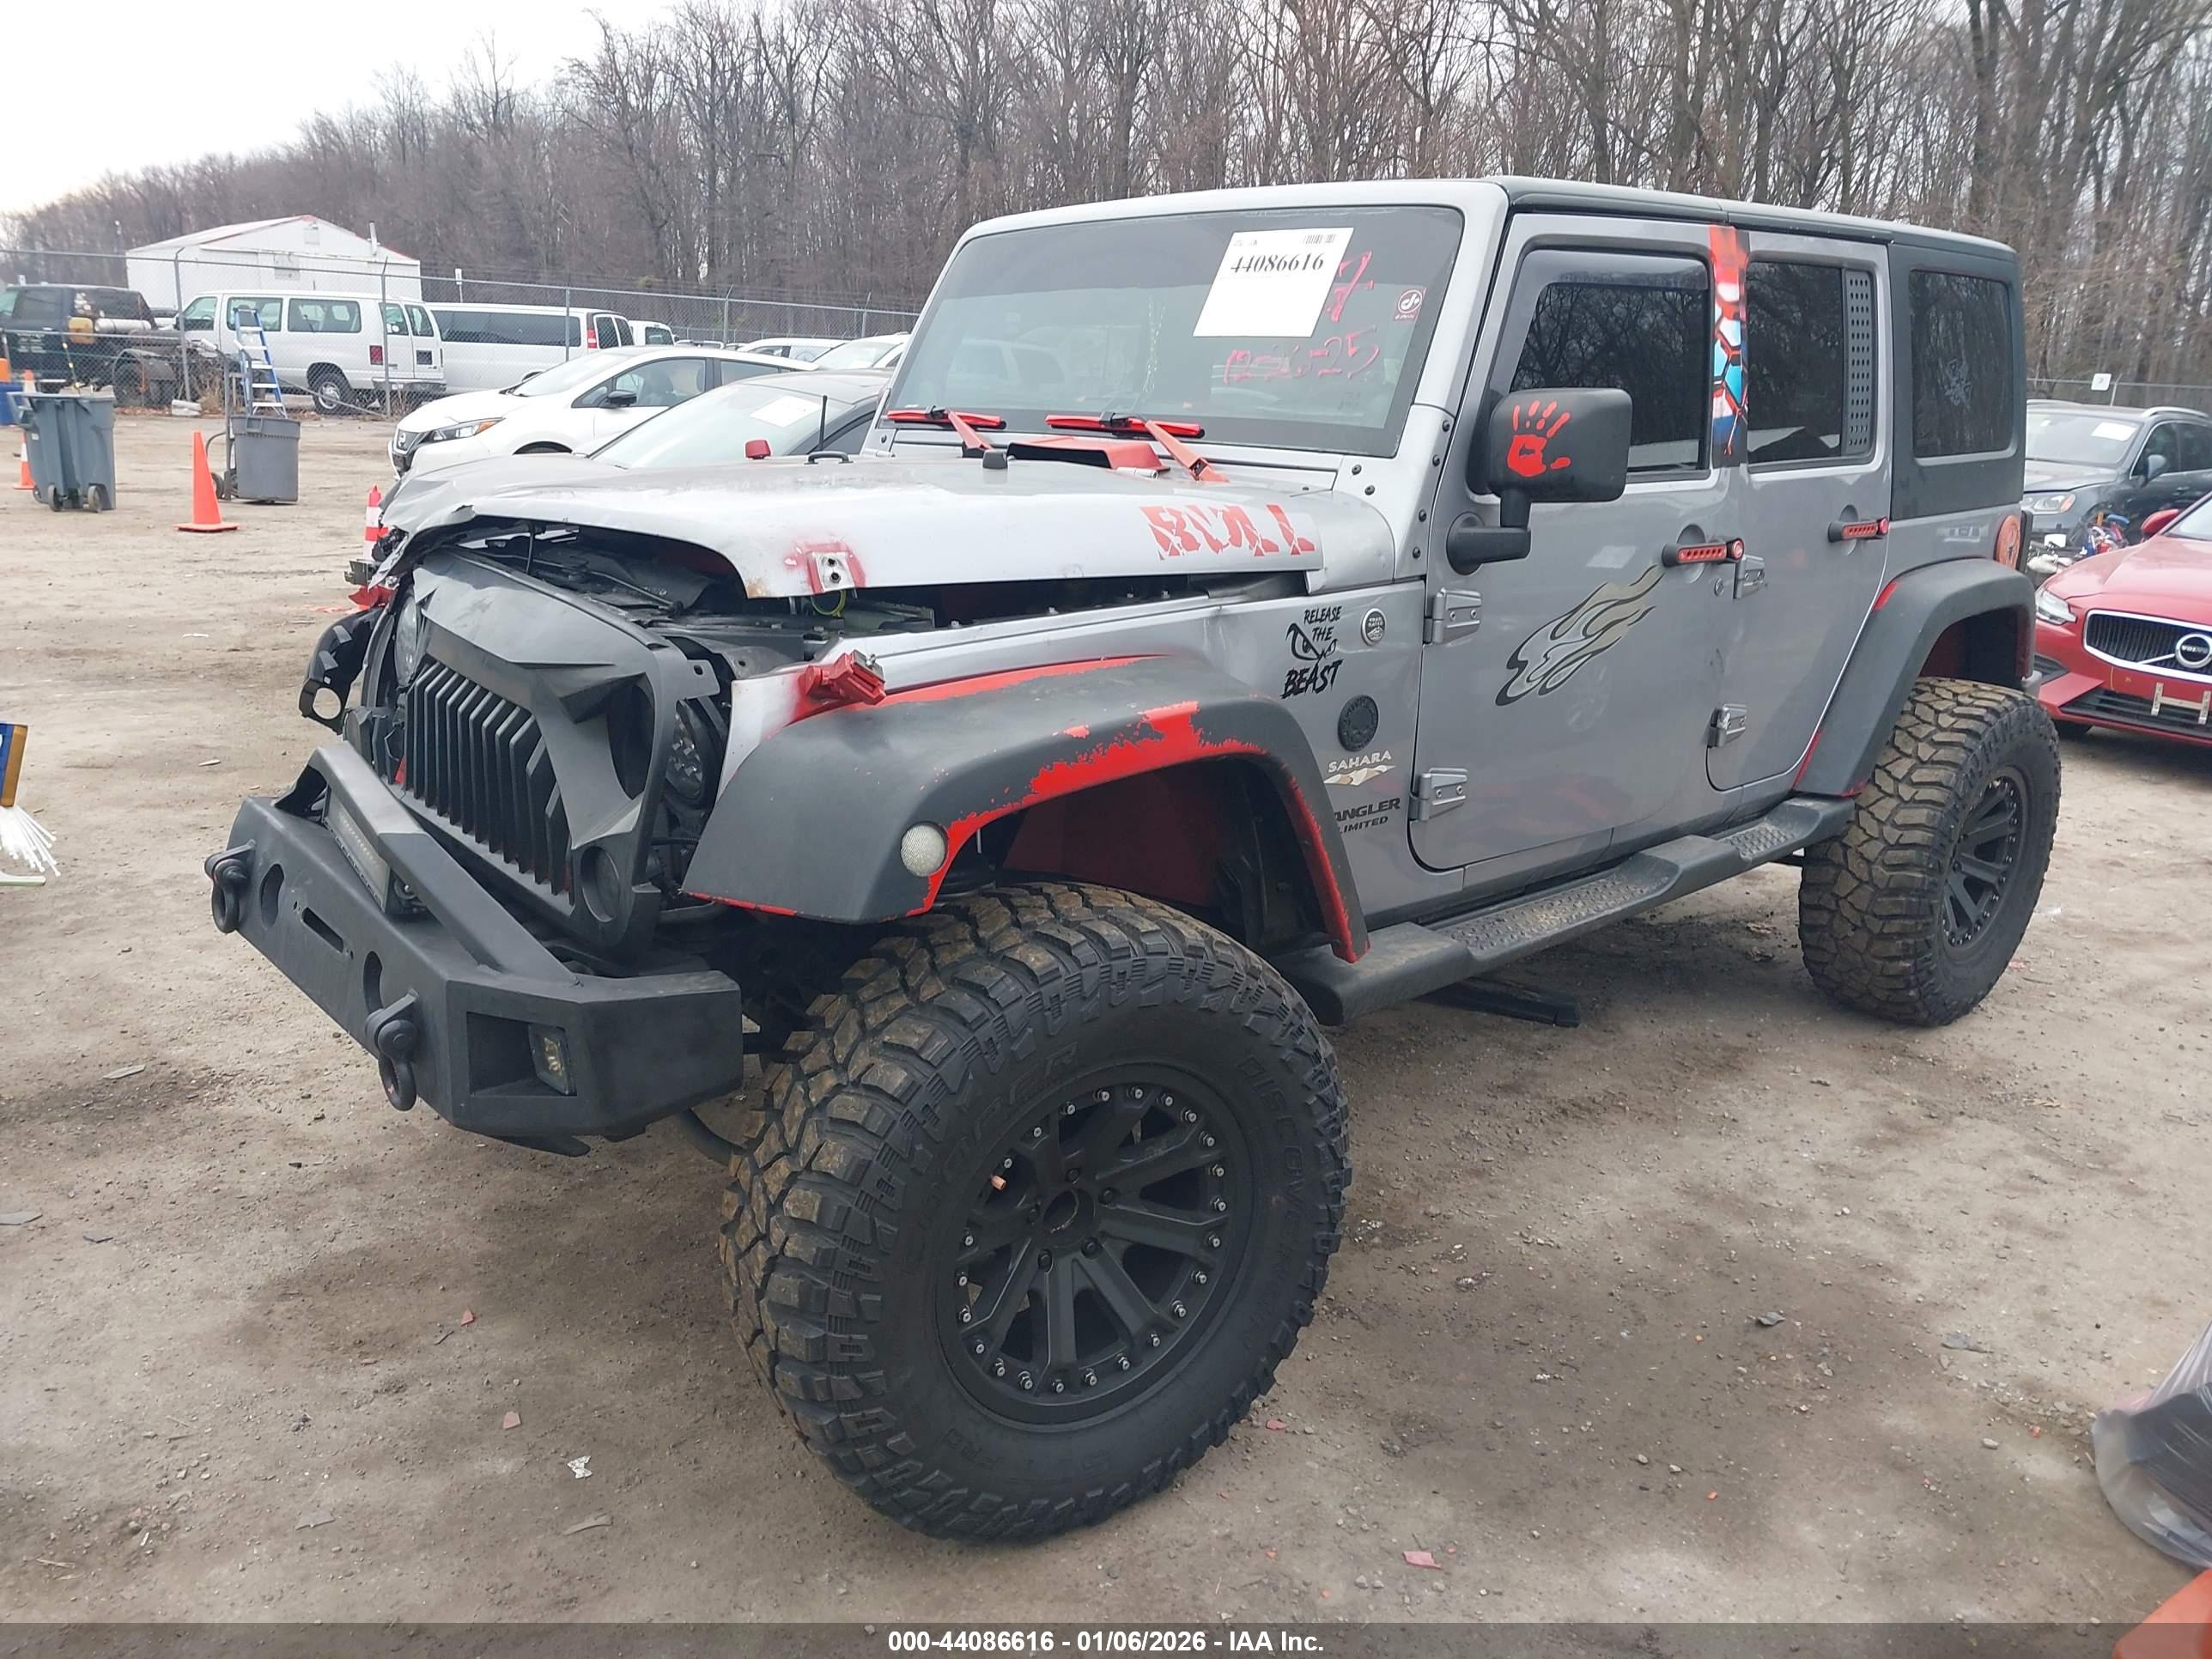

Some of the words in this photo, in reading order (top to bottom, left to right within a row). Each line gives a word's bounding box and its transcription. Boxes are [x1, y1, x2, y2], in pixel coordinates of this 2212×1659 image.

[1231, 252, 1325, 274] 44086616
[1139, 504, 1316, 561] BULL
[1304, 606, 1342, 624] RELEASE
[1311, 626, 1334, 642] THE
[1279, 659, 1343, 700] BEAST
[1328, 750, 1392, 773] SAHARA
[1334, 797, 1401, 822] ANGLER
[1340, 816, 1389, 835] IMITED
